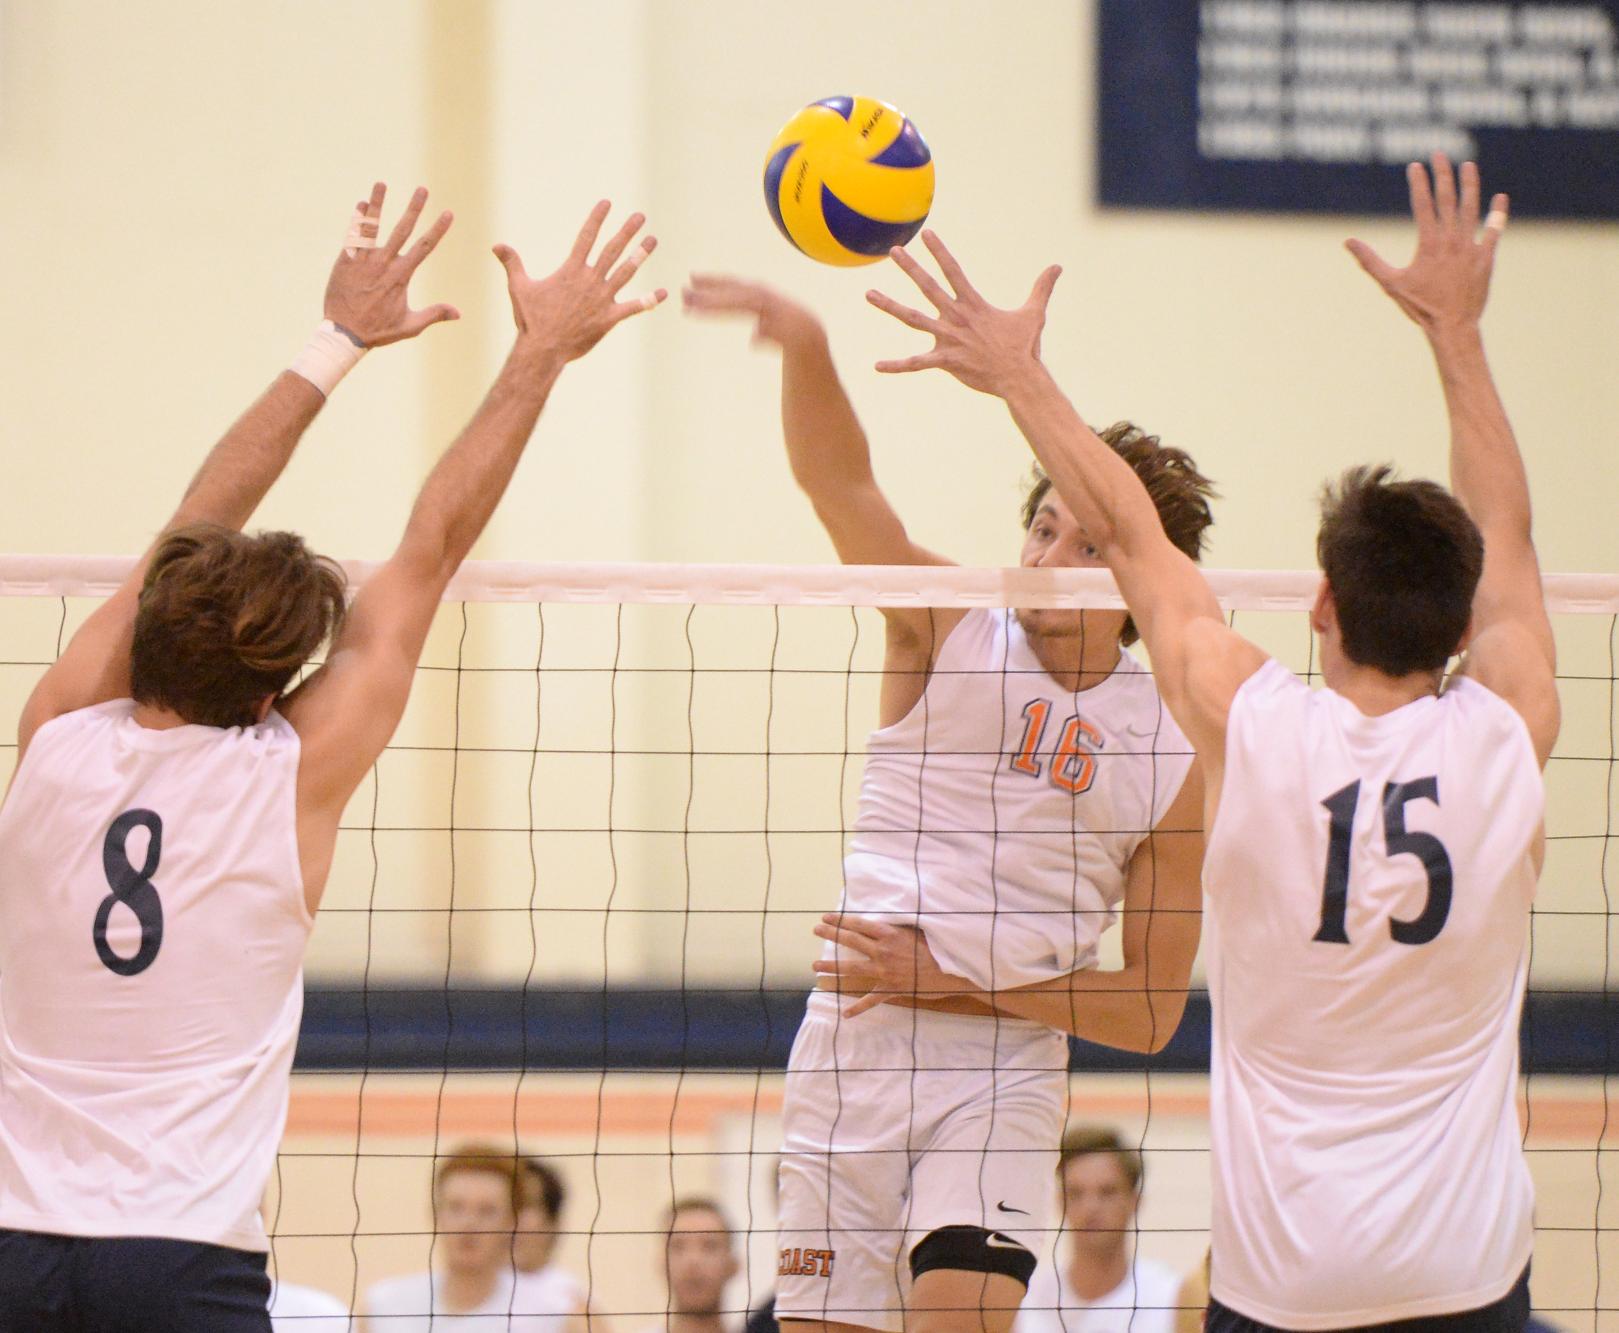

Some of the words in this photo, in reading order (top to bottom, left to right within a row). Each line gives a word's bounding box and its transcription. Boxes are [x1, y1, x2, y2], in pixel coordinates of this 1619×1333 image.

[1010, 697, 1105, 796] 16
[93, 808, 163, 976] 8
[1311, 774, 1453, 945] 15
